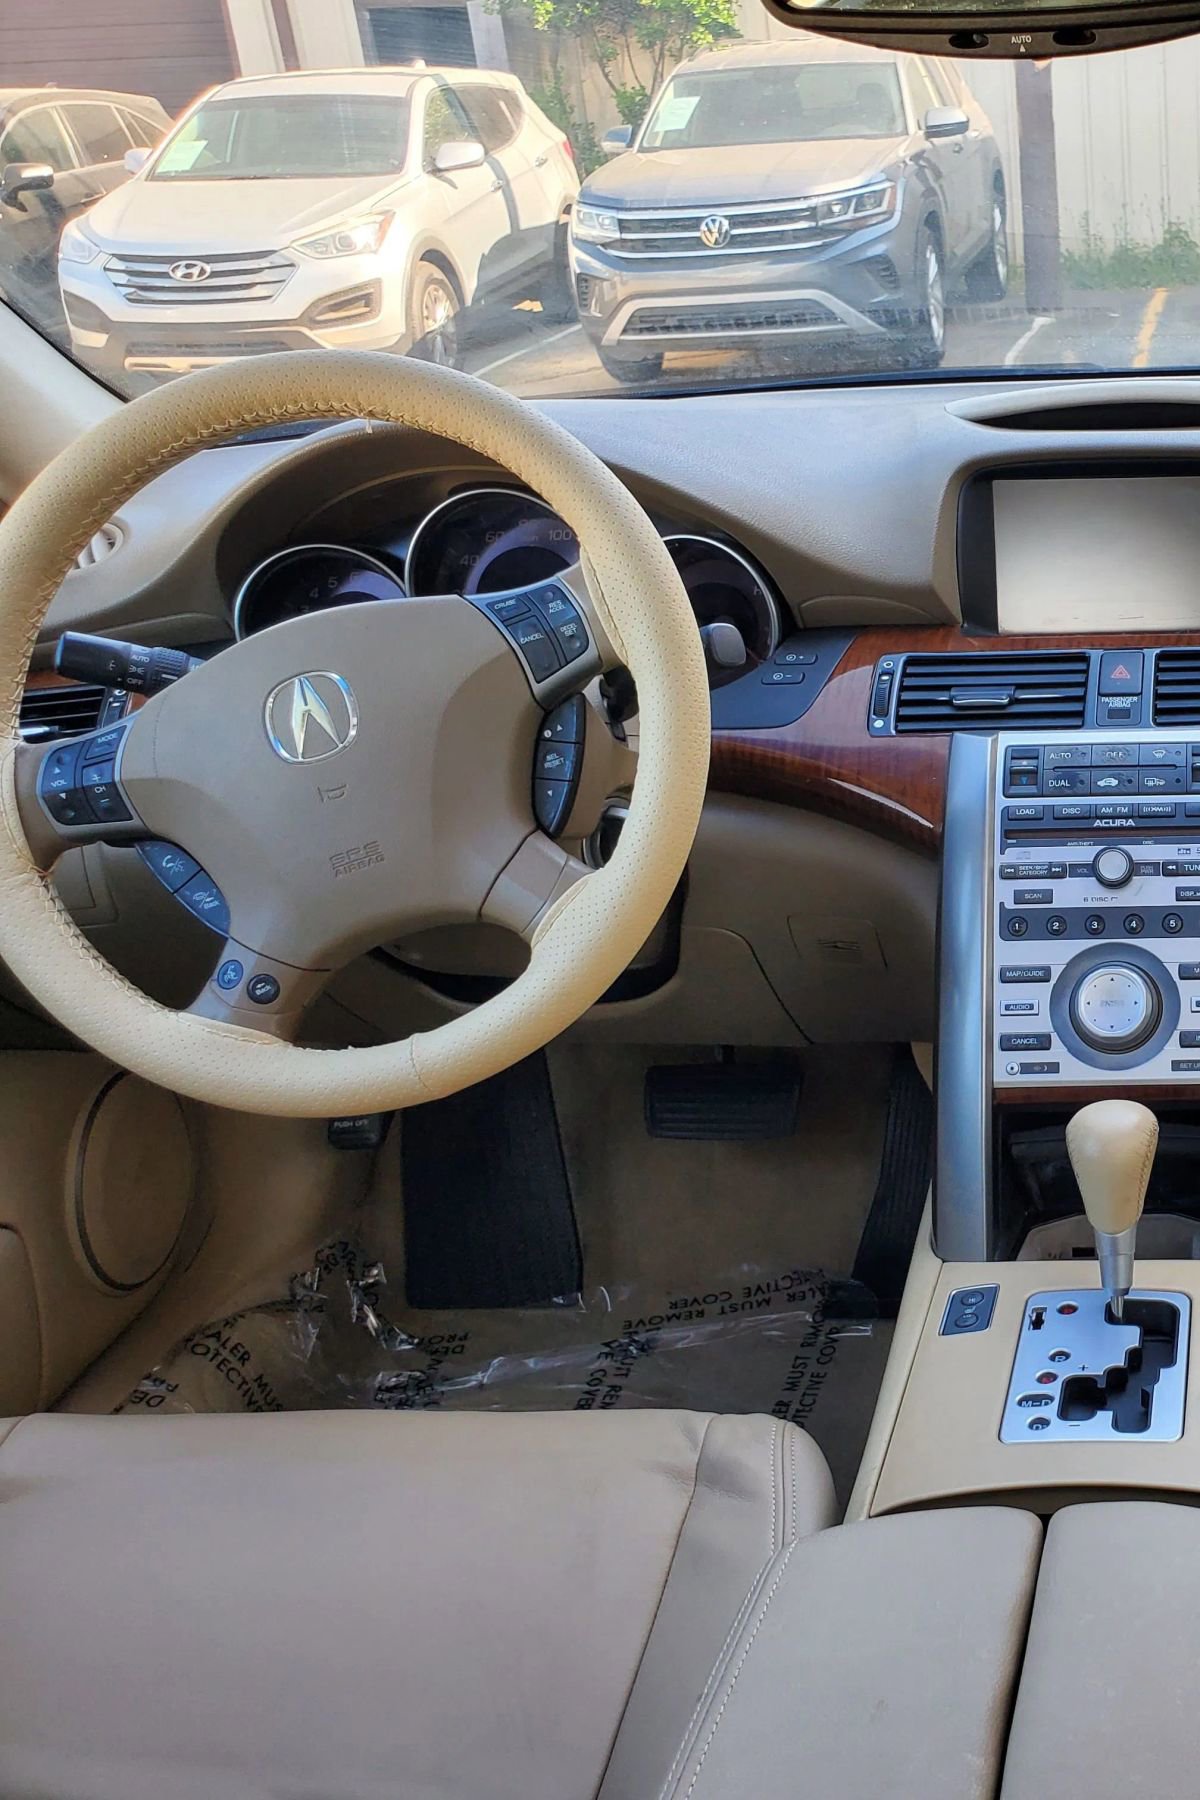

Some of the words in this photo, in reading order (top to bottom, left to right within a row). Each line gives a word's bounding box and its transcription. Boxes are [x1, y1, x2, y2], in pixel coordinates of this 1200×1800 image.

[1011, 35, 1032, 44] AUTO
[548, 529, 573, 541] 100
[327, 576, 338, 589] 5
[494, 598, 517, 610] CRUISE
[564, 628, 577, 637] SET
[520, 633, 544, 644] CANCEL
[131, 653, 150, 663] AUTO
[127, 677, 144, 685] OFF
[97, 732, 118, 743] MODE
[544, 757, 565, 769] RESET
[51, 779, 67, 788] VOL
[1048, 779, 1071, 788] DUAL
[95, 785, 106, 794] CH
[1015, 807, 1035, 815] LOAD
[1062, 806, 1081, 814] DISC
[1101, 806, 1113, 814] AM
[1116, 806, 1129, 814] FM
[1093, 819, 1136, 827] ACURA
[335, 854, 385, 878] AIRBAG
[1052, 922, 1060, 930] 2
[1091, 921, 1098, 929] 3
[1130, 920, 1137, 928] 4
[1169, 919, 1176, 927] 5
[1006, 970, 1045, 978] MAP/GUIDE
[255, 984, 272, 996] Back
[668, 1290, 733, 1310] COVER
[717, 1296, 771, 1316] MUST
[623, 1308, 706, 1330] REMOVE
[782, 1355, 809, 1393] MUST
